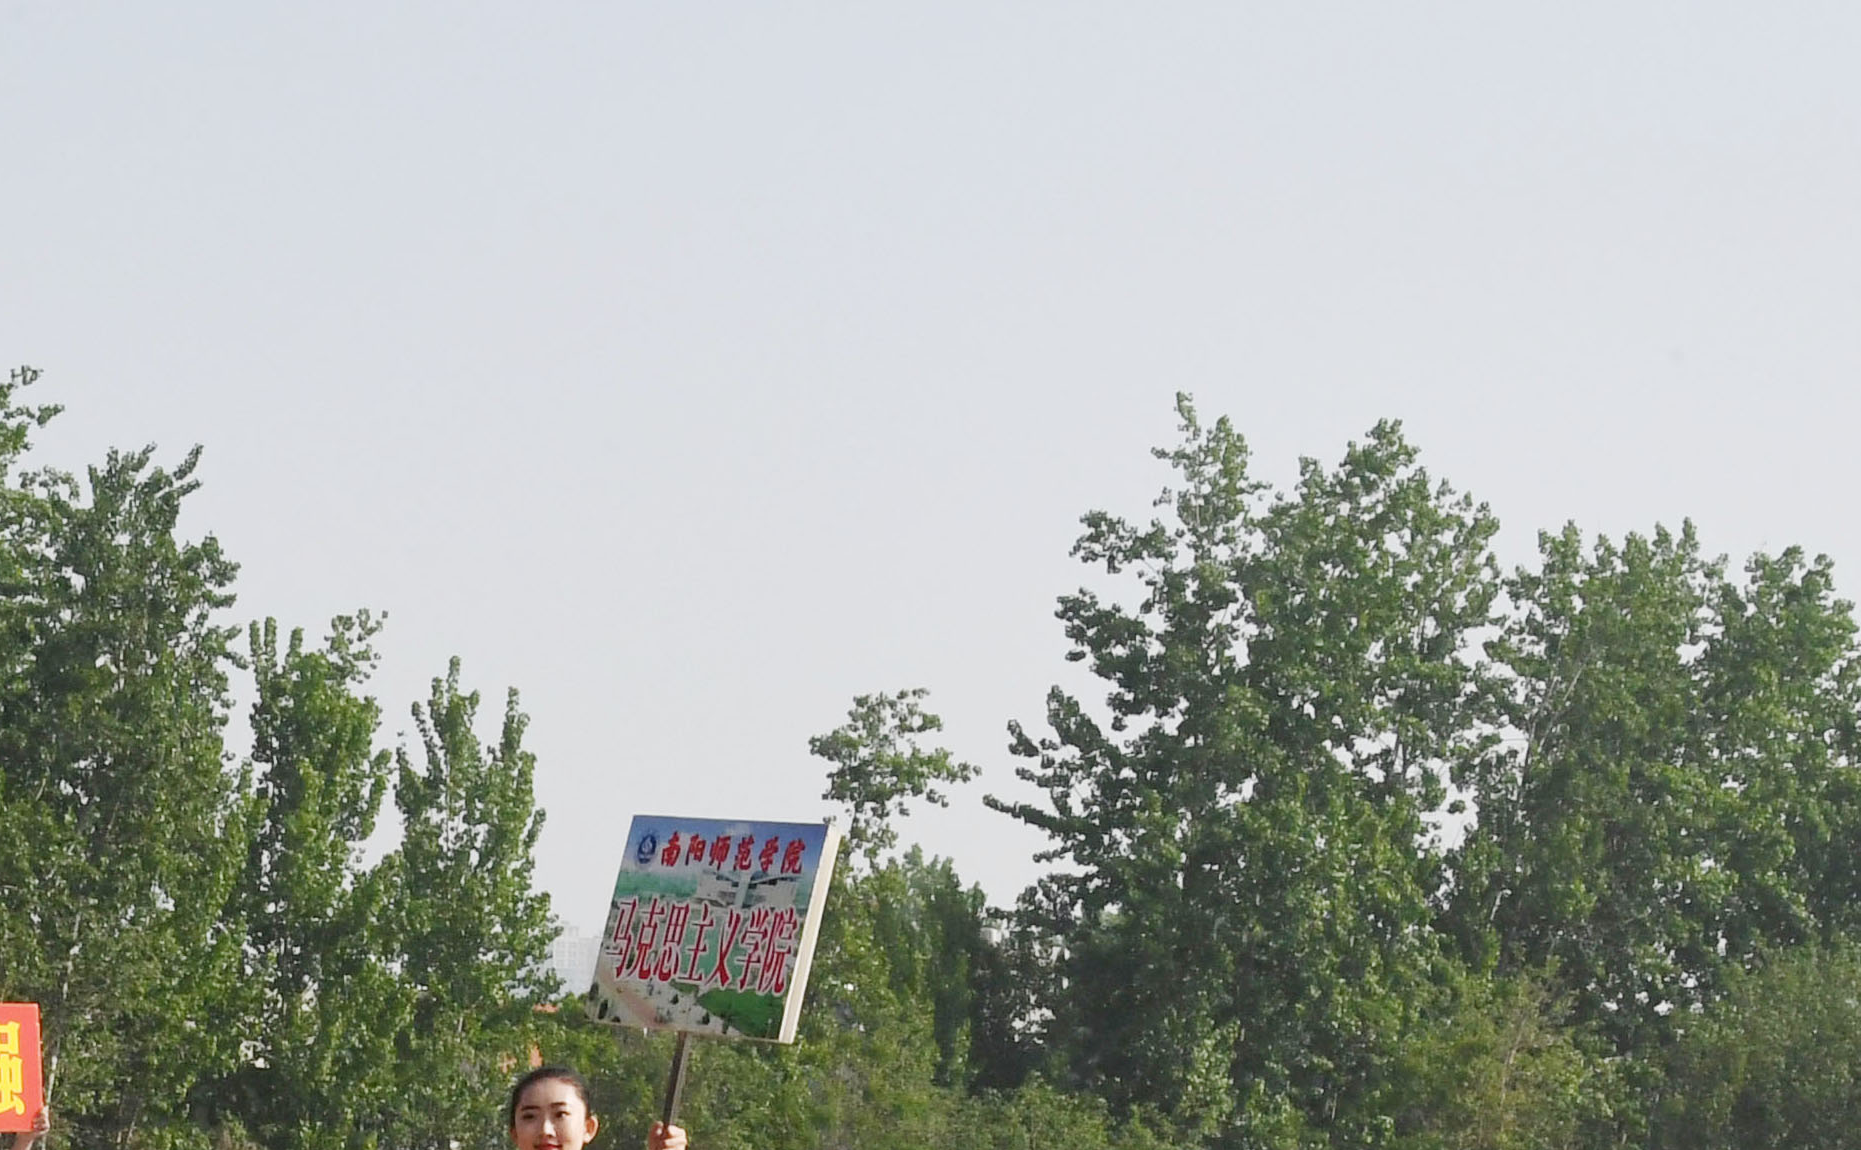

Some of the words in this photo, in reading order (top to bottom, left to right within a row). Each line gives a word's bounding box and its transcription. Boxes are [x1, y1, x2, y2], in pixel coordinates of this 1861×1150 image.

[661, 831, 806, 874] 南阳师范学院
[606, 898, 800, 994] 马克思主义学院
